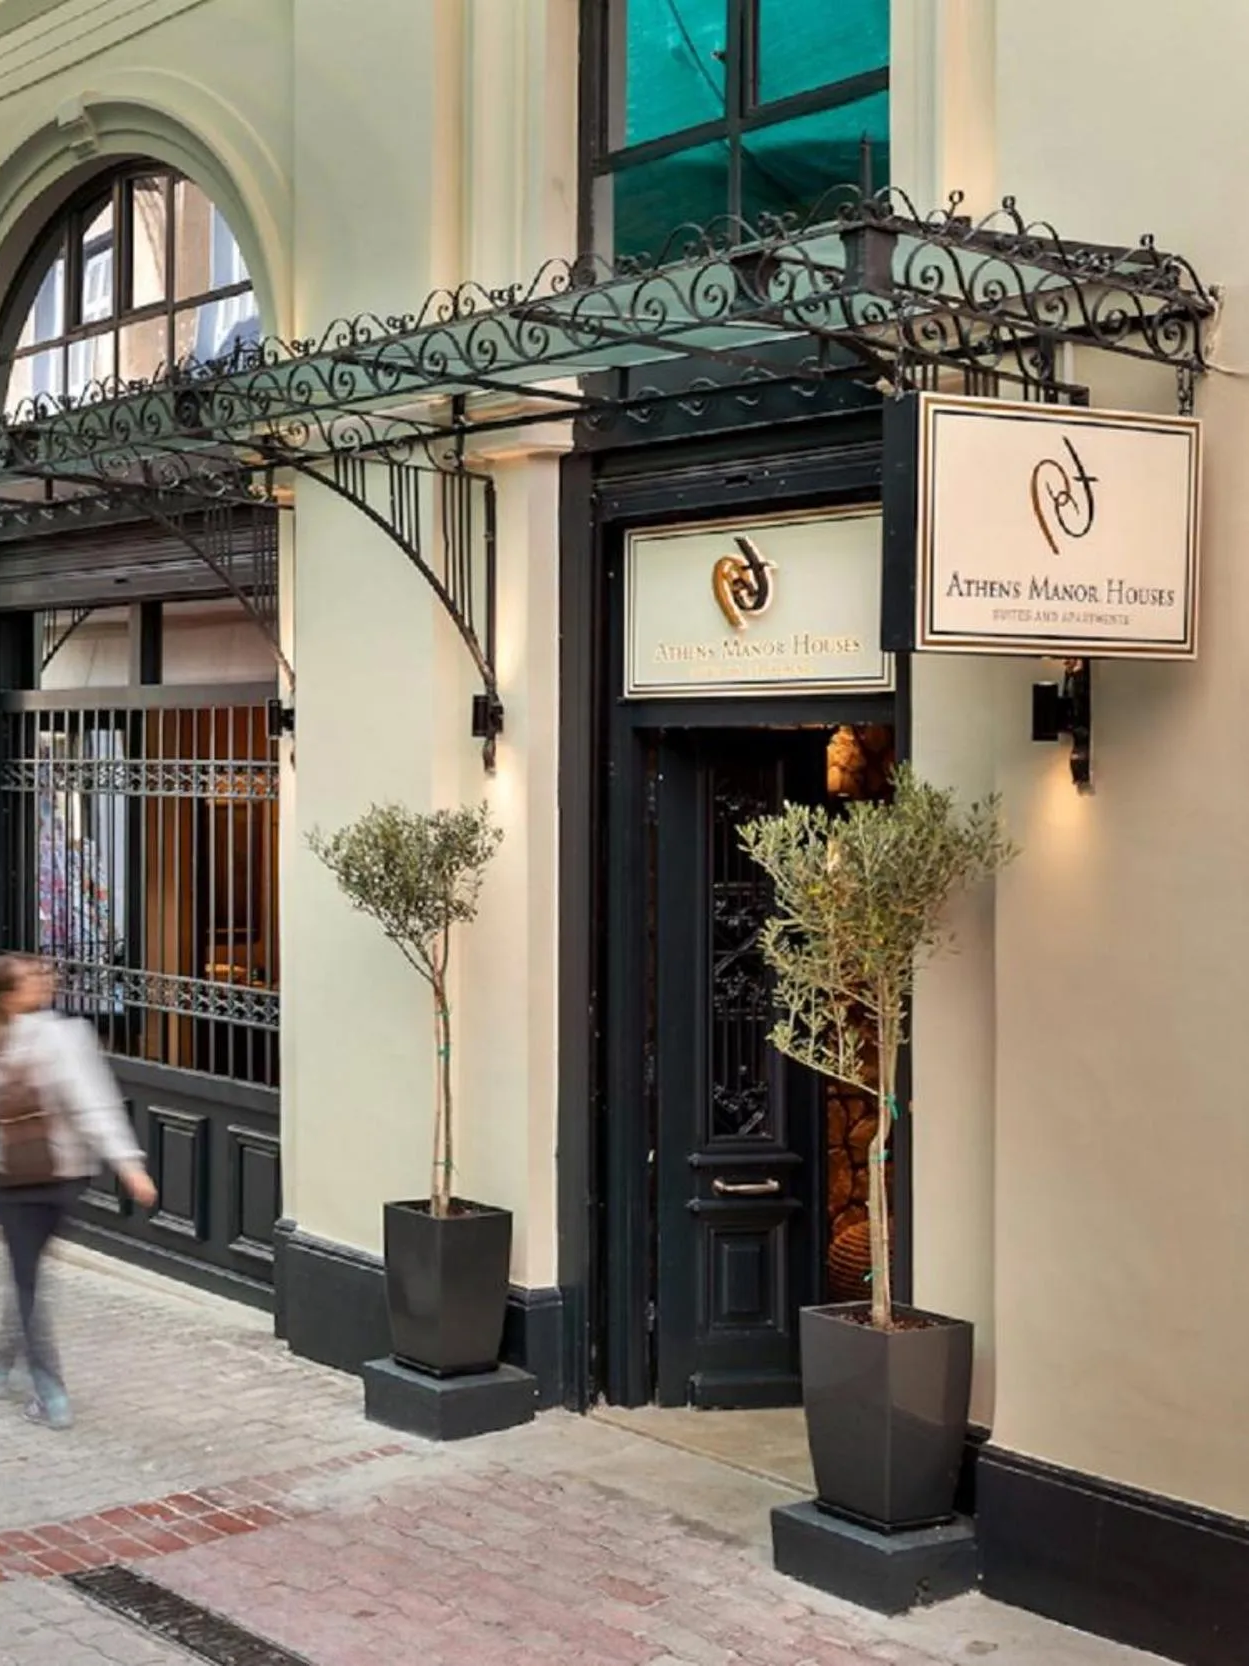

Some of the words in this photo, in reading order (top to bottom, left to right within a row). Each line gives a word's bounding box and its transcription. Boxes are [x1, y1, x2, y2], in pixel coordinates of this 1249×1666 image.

[946, 571, 1021, 599] ATHENS
[1028, 575, 1099, 604] MANOR
[1105, 578, 1175, 607] HOUSES
[721, 638, 786, 660] MANOR
[792, 633, 862, 656] HOUSES
